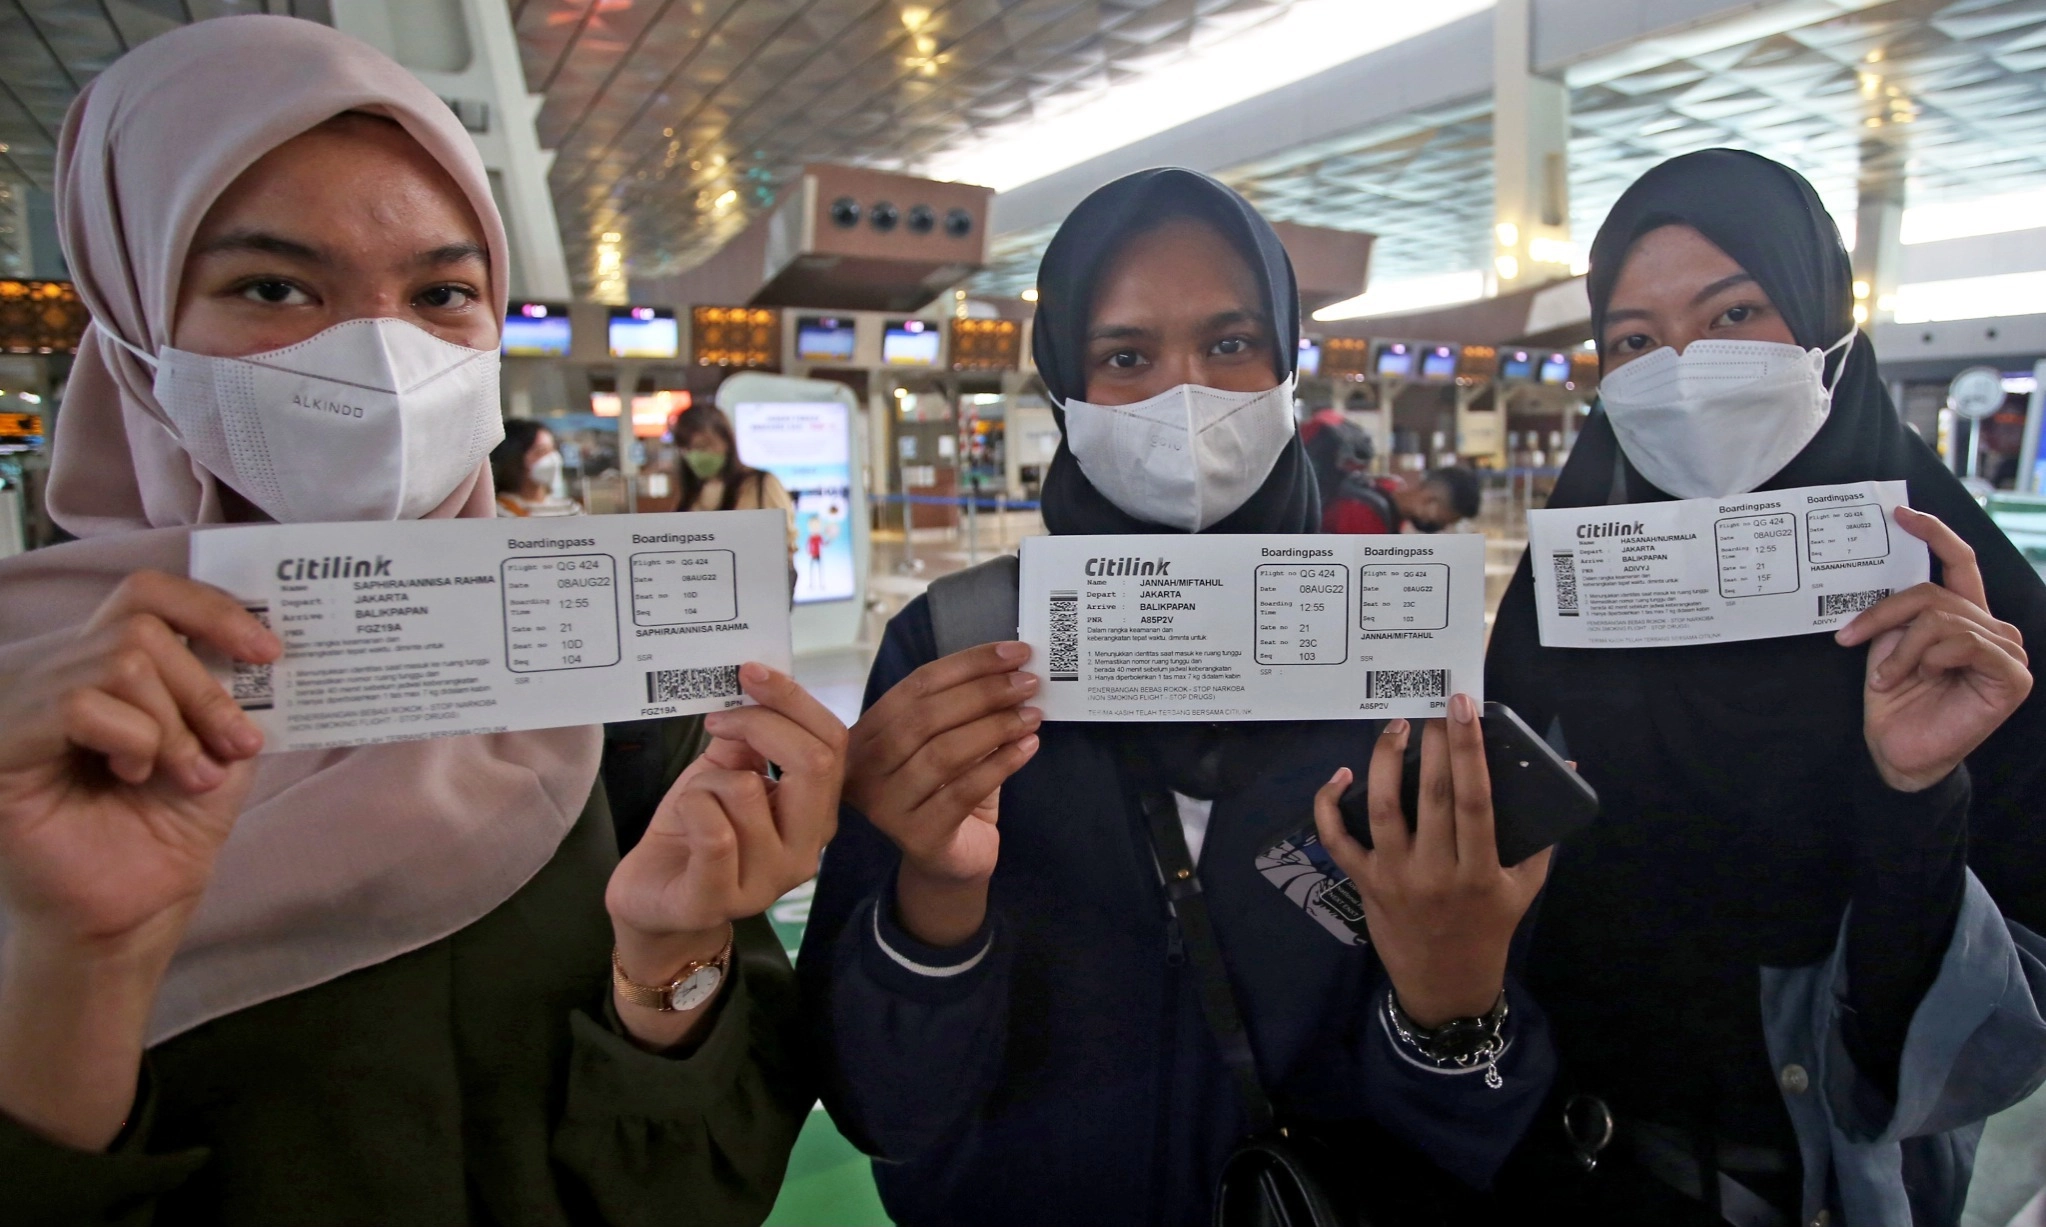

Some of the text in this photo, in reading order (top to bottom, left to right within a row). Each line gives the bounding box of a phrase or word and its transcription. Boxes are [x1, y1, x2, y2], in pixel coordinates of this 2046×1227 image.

[292, 394, 364, 418] ALKINDO
[1807, 493, 1864, 504] Boardingpass
[1719, 502, 1781, 514] Boardingpass
[1753, 519, 1767, 527] QG
[1769, 517, 1784, 525] 424
[1576, 521, 1645, 539] Citilink
[1753, 529, 1792, 539] 08AUG22
[632, 533, 715, 544] Boardingpass
[1621, 533, 1697, 544] HASANAH/NURMALIA
[507, 538, 596, 550] Boardingpass
[1621, 545, 1655, 553] JAKARTA
[1261, 547, 1334, 558] Boardingpass
[1364, 547, 1434, 557] Boardingpass
[1622, 554, 1668, 562] BALIKPAPAN
[276, 554, 393, 581] Citilink
[556, 561, 576, 571] QG
[579, 560, 599, 570] 424
[1084, 557, 1171, 577] Citilink
[1756, 562, 1765, 570] 21
[1811, 559, 1885, 571] HASANAH/NURMALIA
[1300, 569, 1316, 578] QG
[1757, 574, 1772, 582] 15F
[353, 575, 496, 590] SAPHIRA/ANNISA RAHMA
[557, 576, 610, 588] 08AUG22
[1139, 579, 1223, 587] JANNAH/MIFTAHUL
[1300, 585, 1344, 594] 08AUG22
[354, 593, 409, 604] JAKARTA
[355, 606, 429, 619] BALIKPAPAN
[1300, 603, 1325, 612] 12:55
[1141, 616, 1174, 624] A85P2V
[1812, 618, 1837, 626] ADIVYJ
[357, 623, 402, 633] FGZ19A
[560, 623, 573, 633] 21
[636, 623, 749, 637] SAPHIRA/ANNISA RAHMA
[1299, 624, 1310, 632] 21
[1360, 632, 1434, 640] JANNAH/MIFTAHUL
[561, 639, 583, 649] 10D
[1299, 639, 1318, 647] 23C
[561, 655, 582, 664] 104
[1299, 652, 1316, 660] 103
[724, 700, 743, 708] BPN
[641, 706, 677, 716] FGZ19A
